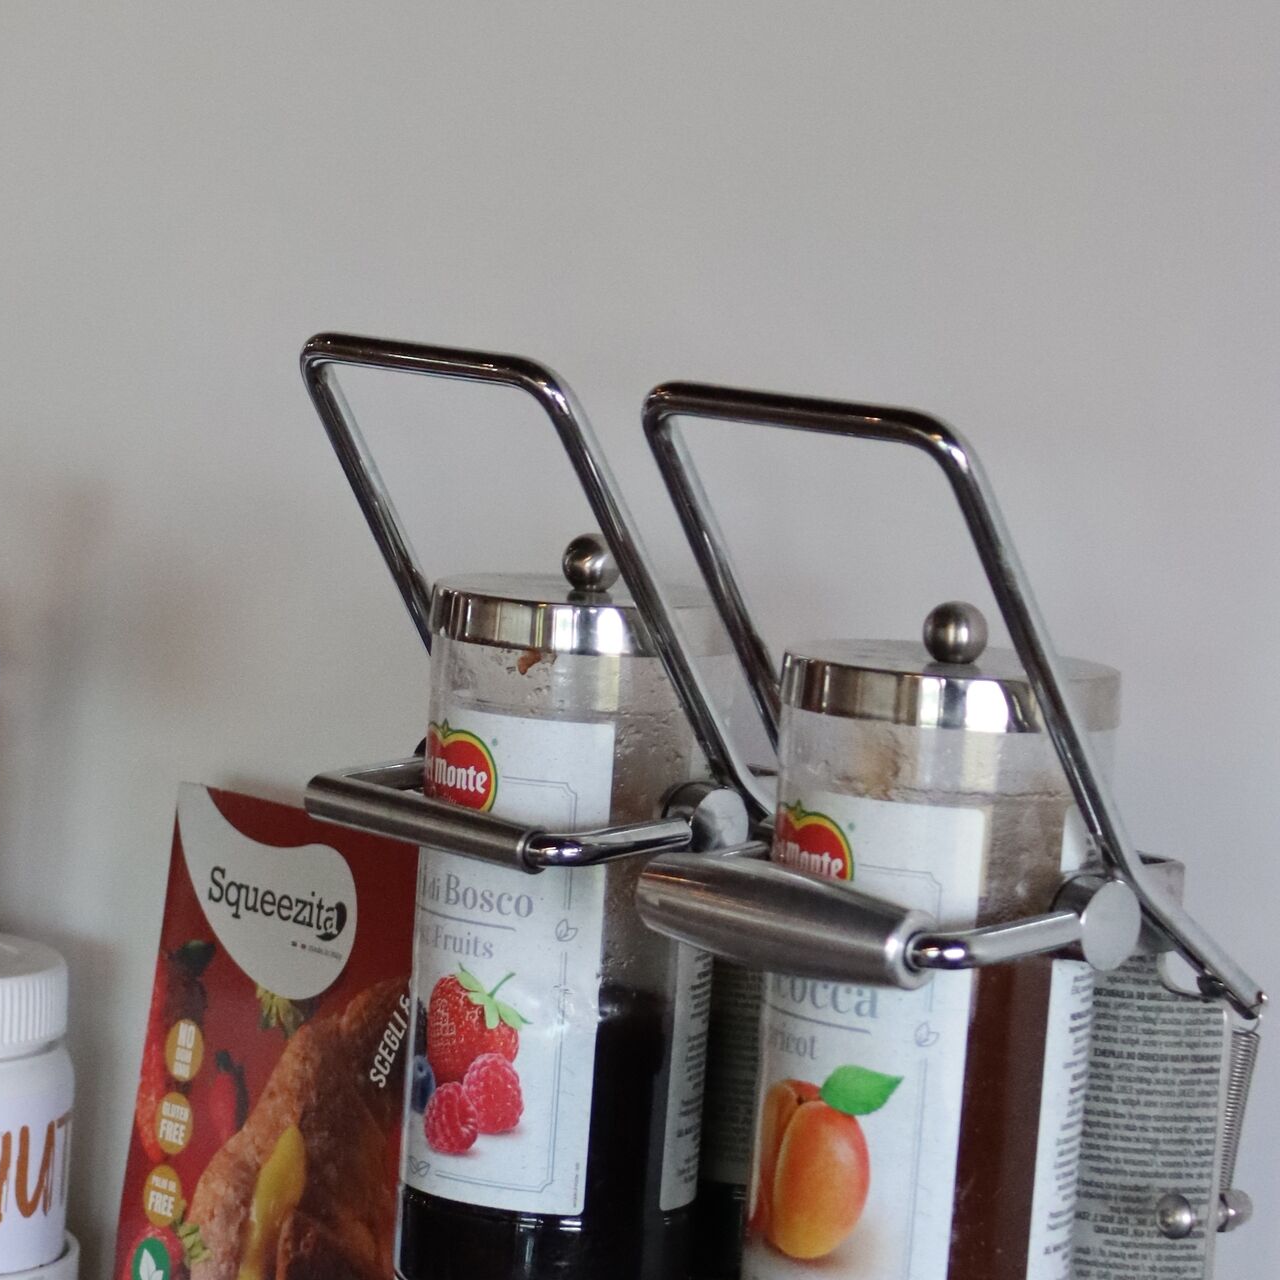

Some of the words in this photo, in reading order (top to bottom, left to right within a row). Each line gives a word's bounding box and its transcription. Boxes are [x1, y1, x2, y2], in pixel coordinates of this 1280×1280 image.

[434, 757, 488, 794] Monte
[208, 865, 347, 941] Squeezita
[444, 873, 534, 918] Bosco
[433, 924, 494, 959] Fruits
[370, 1010, 408, 1089] SCEGLI
[158, 1119, 186, 1146] FREE
[148, 1190, 175, 1217] FREE
